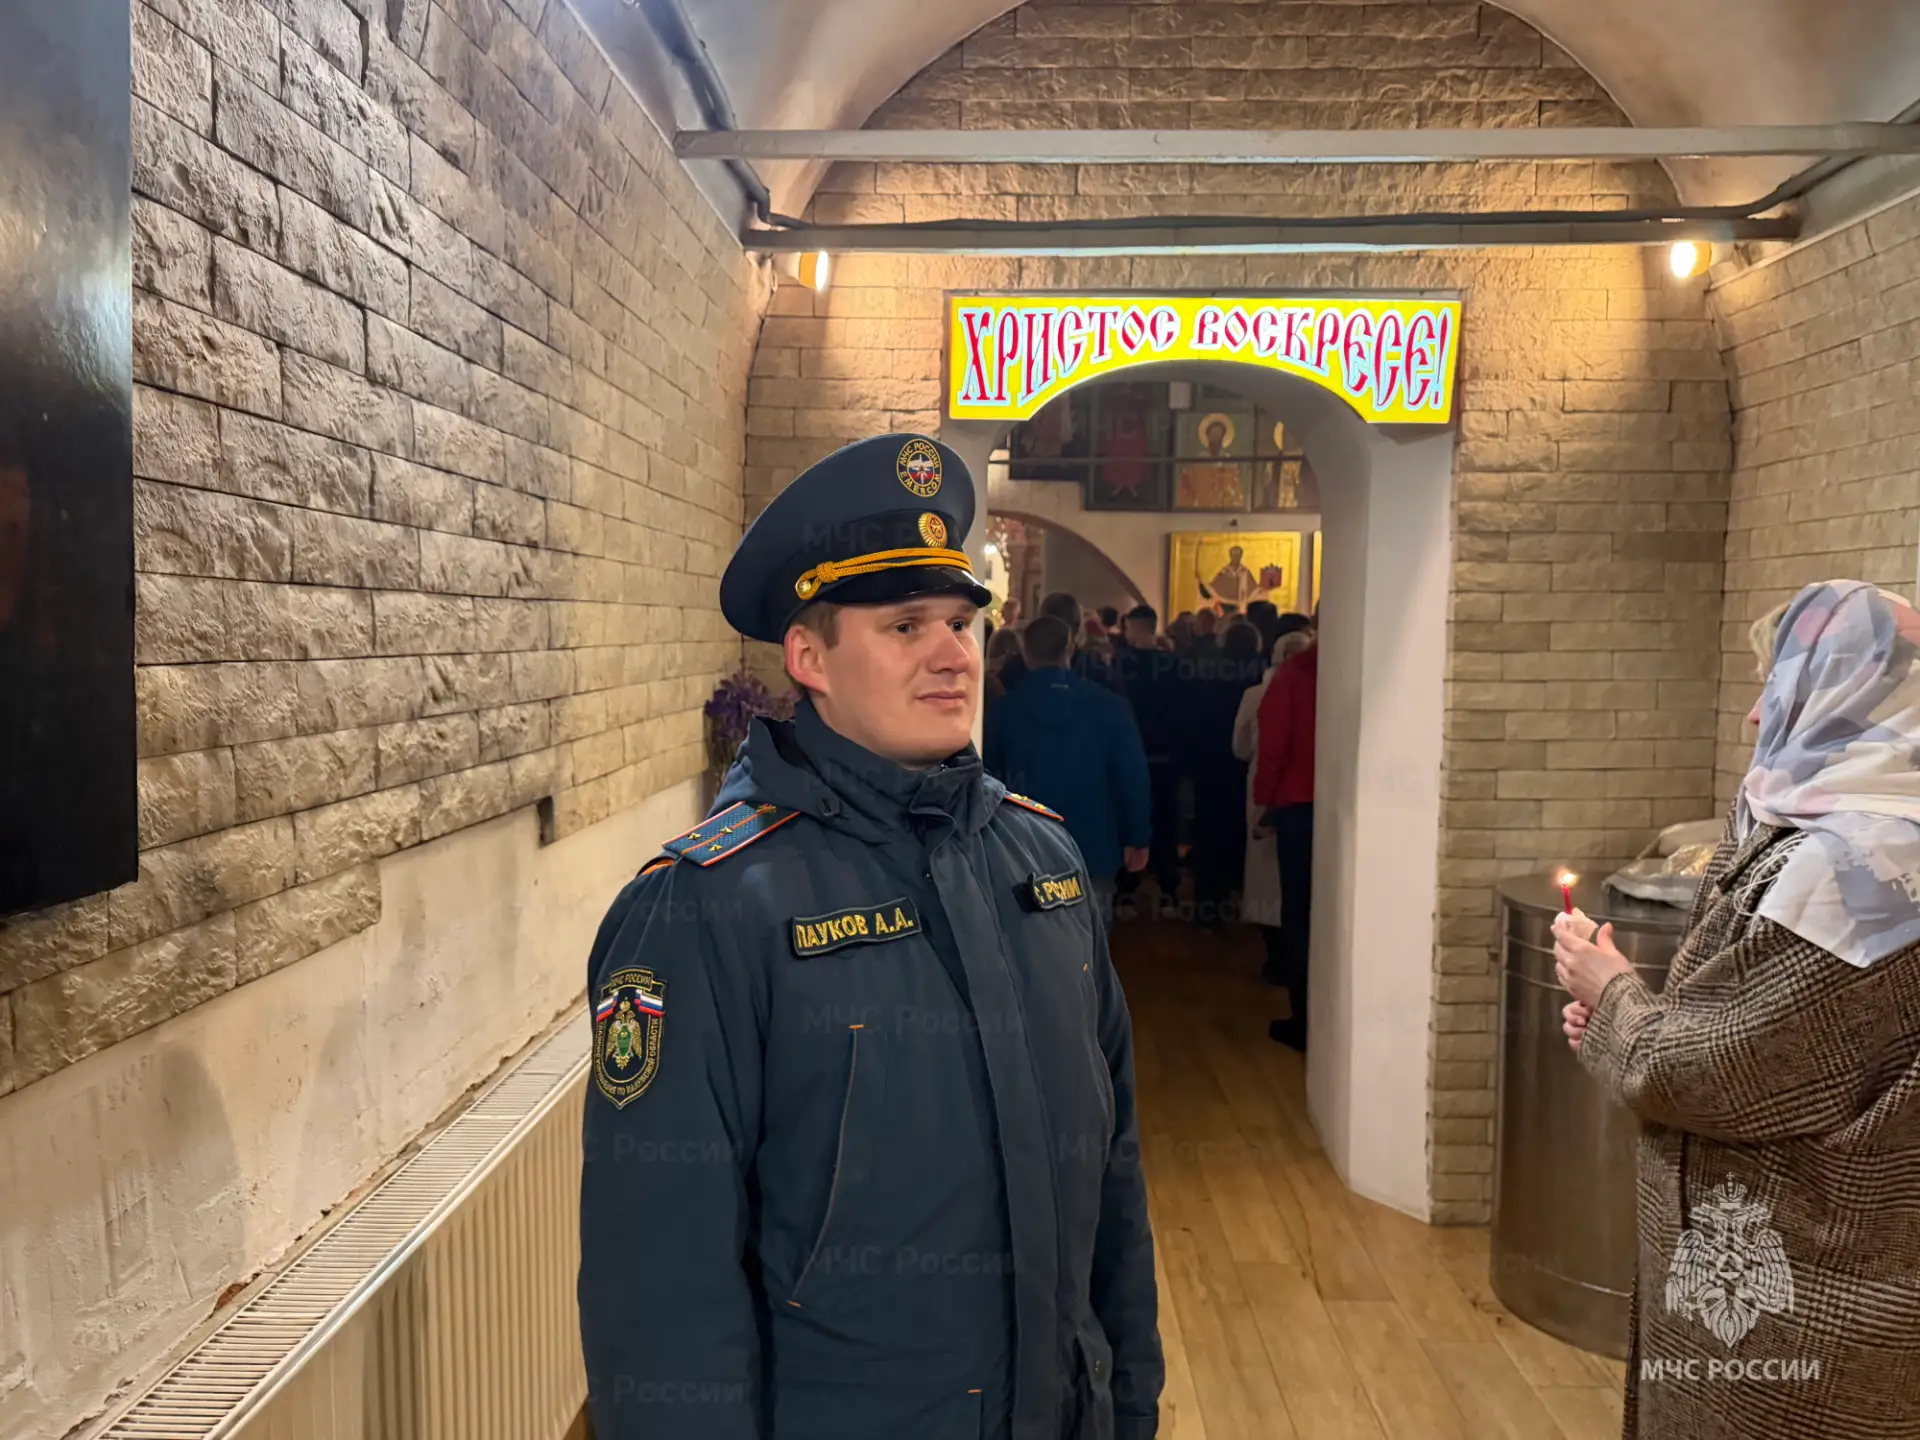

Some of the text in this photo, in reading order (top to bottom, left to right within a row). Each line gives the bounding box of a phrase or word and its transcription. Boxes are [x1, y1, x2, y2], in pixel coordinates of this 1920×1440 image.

[958, 306, 1180, 404] ХРИСТОС
[900, 442, 939, 468] МЧС РОССИИ
[900, 471, 940, 495] EMERCOM
[796, 907, 914, 948] ПАУКОВ А.А.
